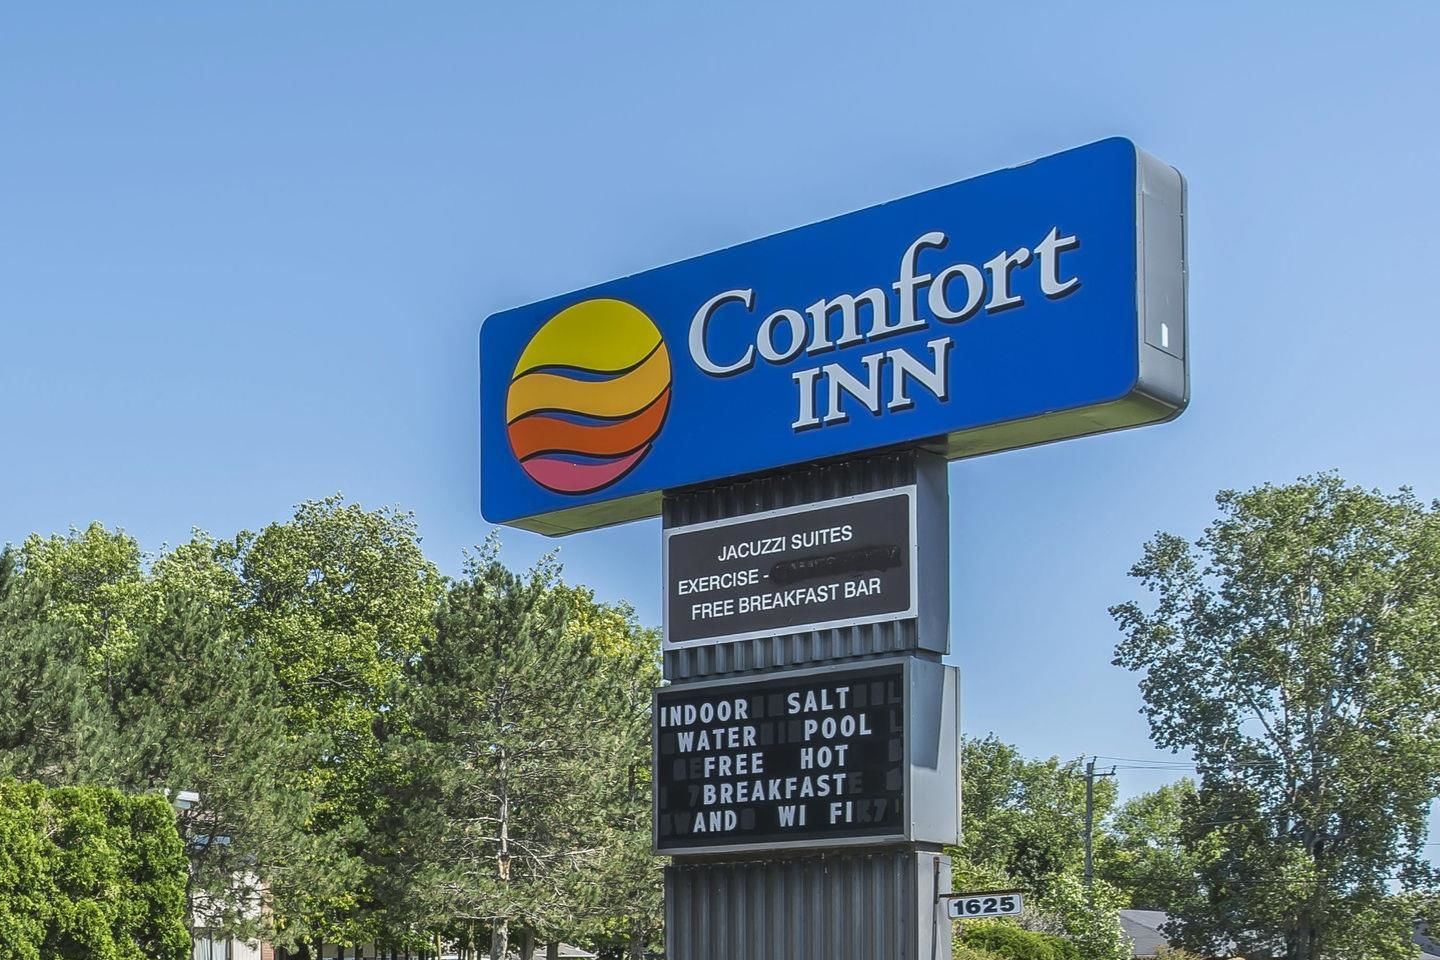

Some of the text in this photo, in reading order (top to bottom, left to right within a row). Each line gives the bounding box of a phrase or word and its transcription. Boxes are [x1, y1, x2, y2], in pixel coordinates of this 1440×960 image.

[688, 226, 1078, 374] Comfort
[791, 337, 952, 431] INN
[718, 536, 786, 561] JACUZZI
[791, 525, 852, 550] SUITES
[678, 569, 759, 595] EXERCISE
[692, 577, 881, 620] FREE BREAKFAST BAR
[660, 686, 849, 727] INDOOR SALT
[677, 713, 872, 753] WATER POOL
[704, 745, 848, 777] FREE HOT
[703, 773, 847, 805] BREAKFAST
[693, 801, 853, 833] AND WI FI
[953, 897, 1015, 915] 1625
